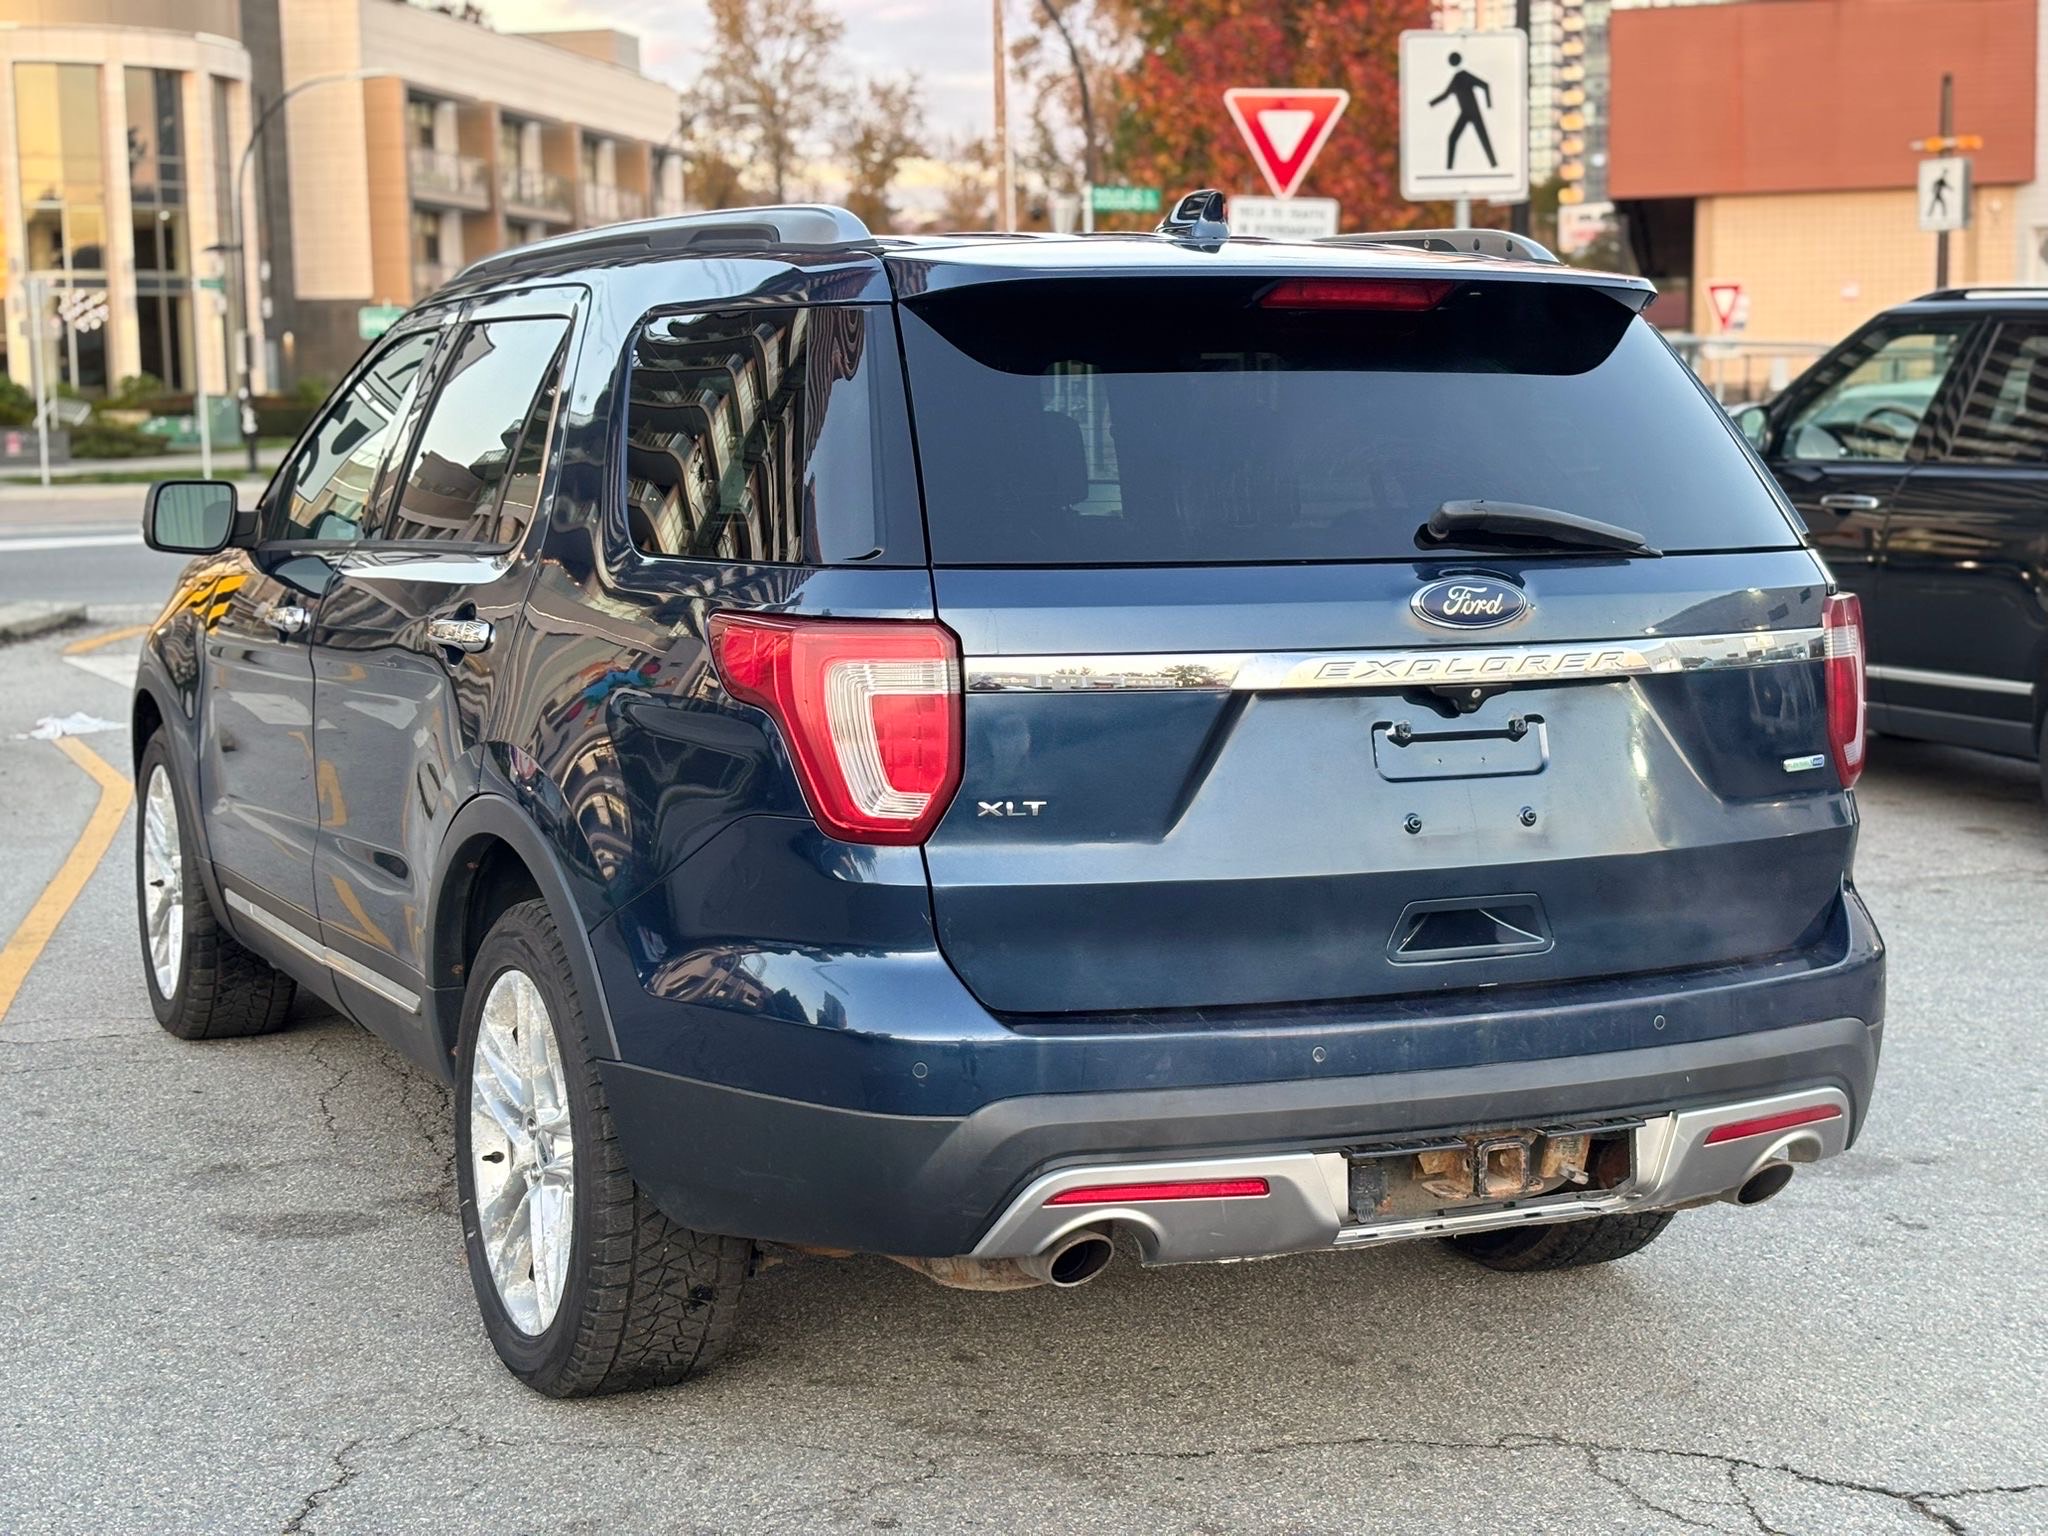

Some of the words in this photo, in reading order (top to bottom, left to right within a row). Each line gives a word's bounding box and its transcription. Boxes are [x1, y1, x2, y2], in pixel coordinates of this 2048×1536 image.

[1442, 585, 1504, 615] Ford
[1313, 650, 1626, 680] EXPLORER
[977, 801, 1048, 817] XLT
